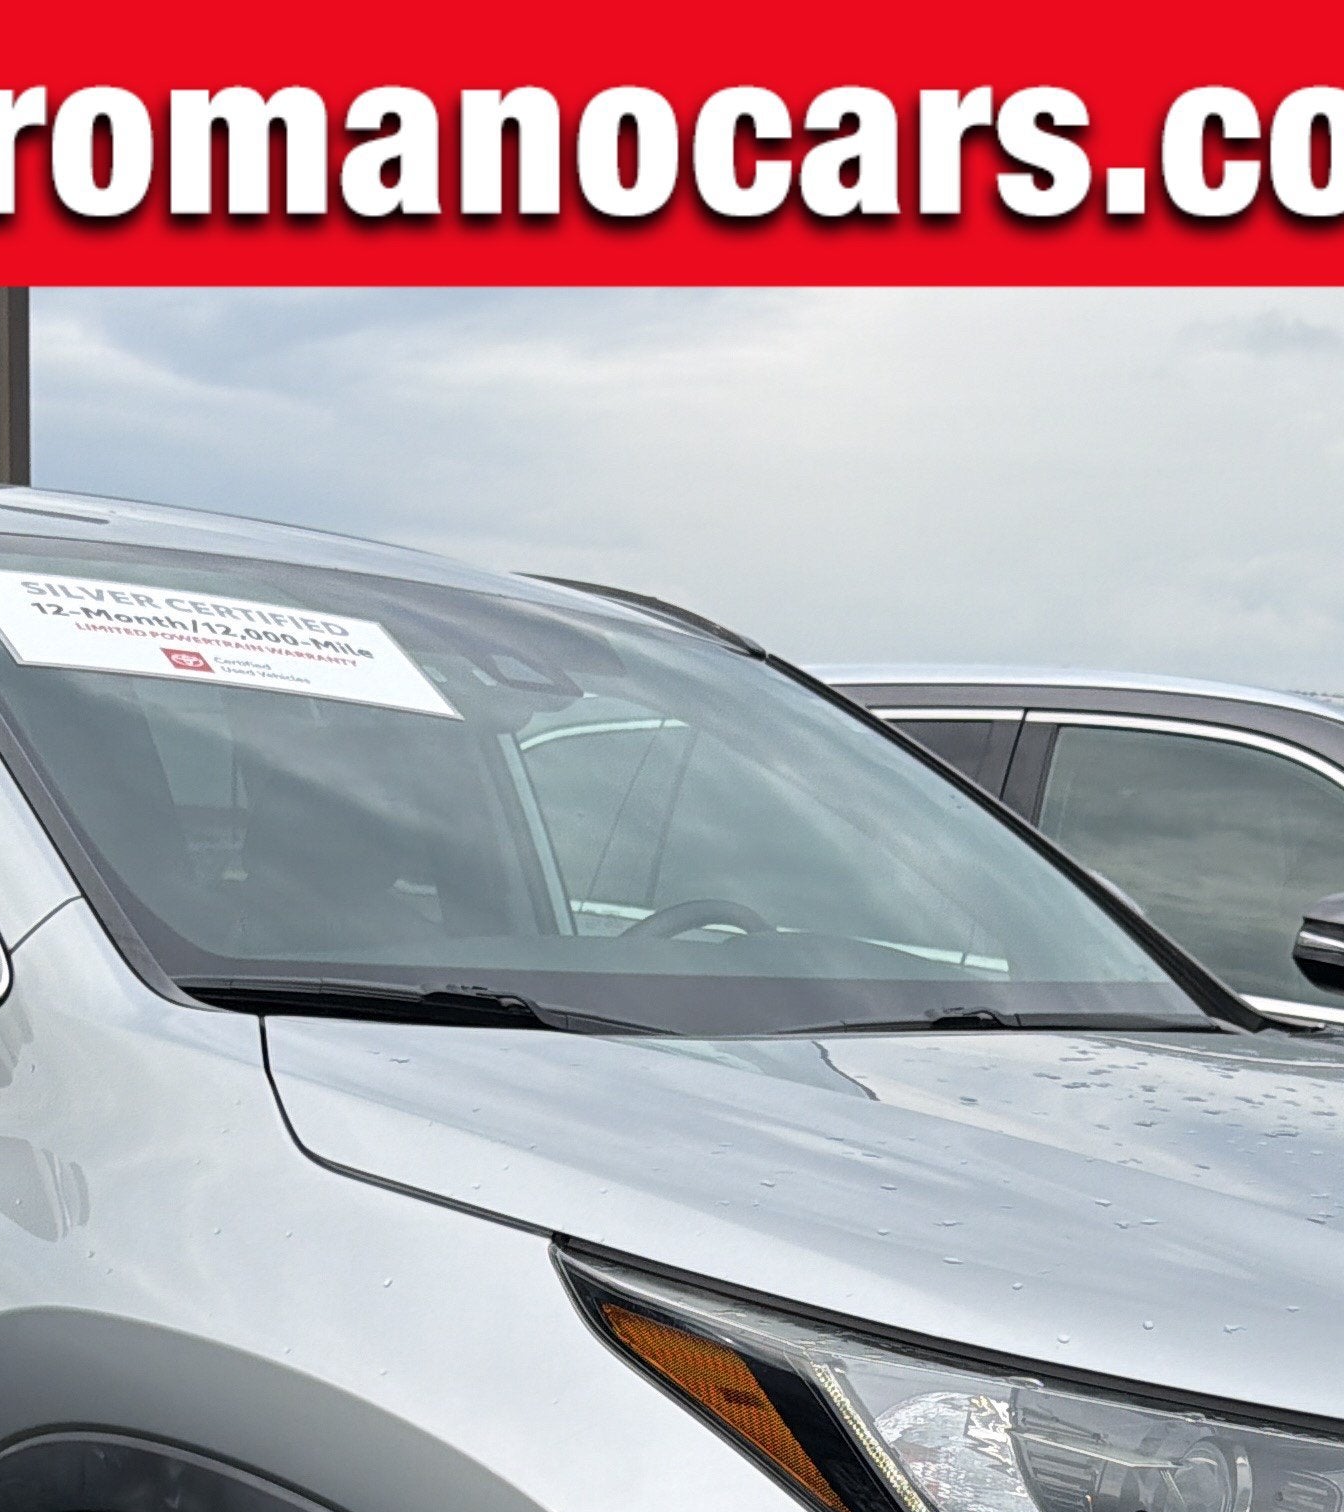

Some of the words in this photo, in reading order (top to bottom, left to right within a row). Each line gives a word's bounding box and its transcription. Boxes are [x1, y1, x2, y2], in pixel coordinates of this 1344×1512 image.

[21, 581, 161, 609] SILVER
[165, 598, 349, 636] CERTIFIED
[31, 602, 374, 659] 12-Month/12,000-Mile
[74, 622, 146, 637] LIMITED
[149, 630, 264, 652] POWERTRAIN
[265, 645, 357, 667] WARRANTY
